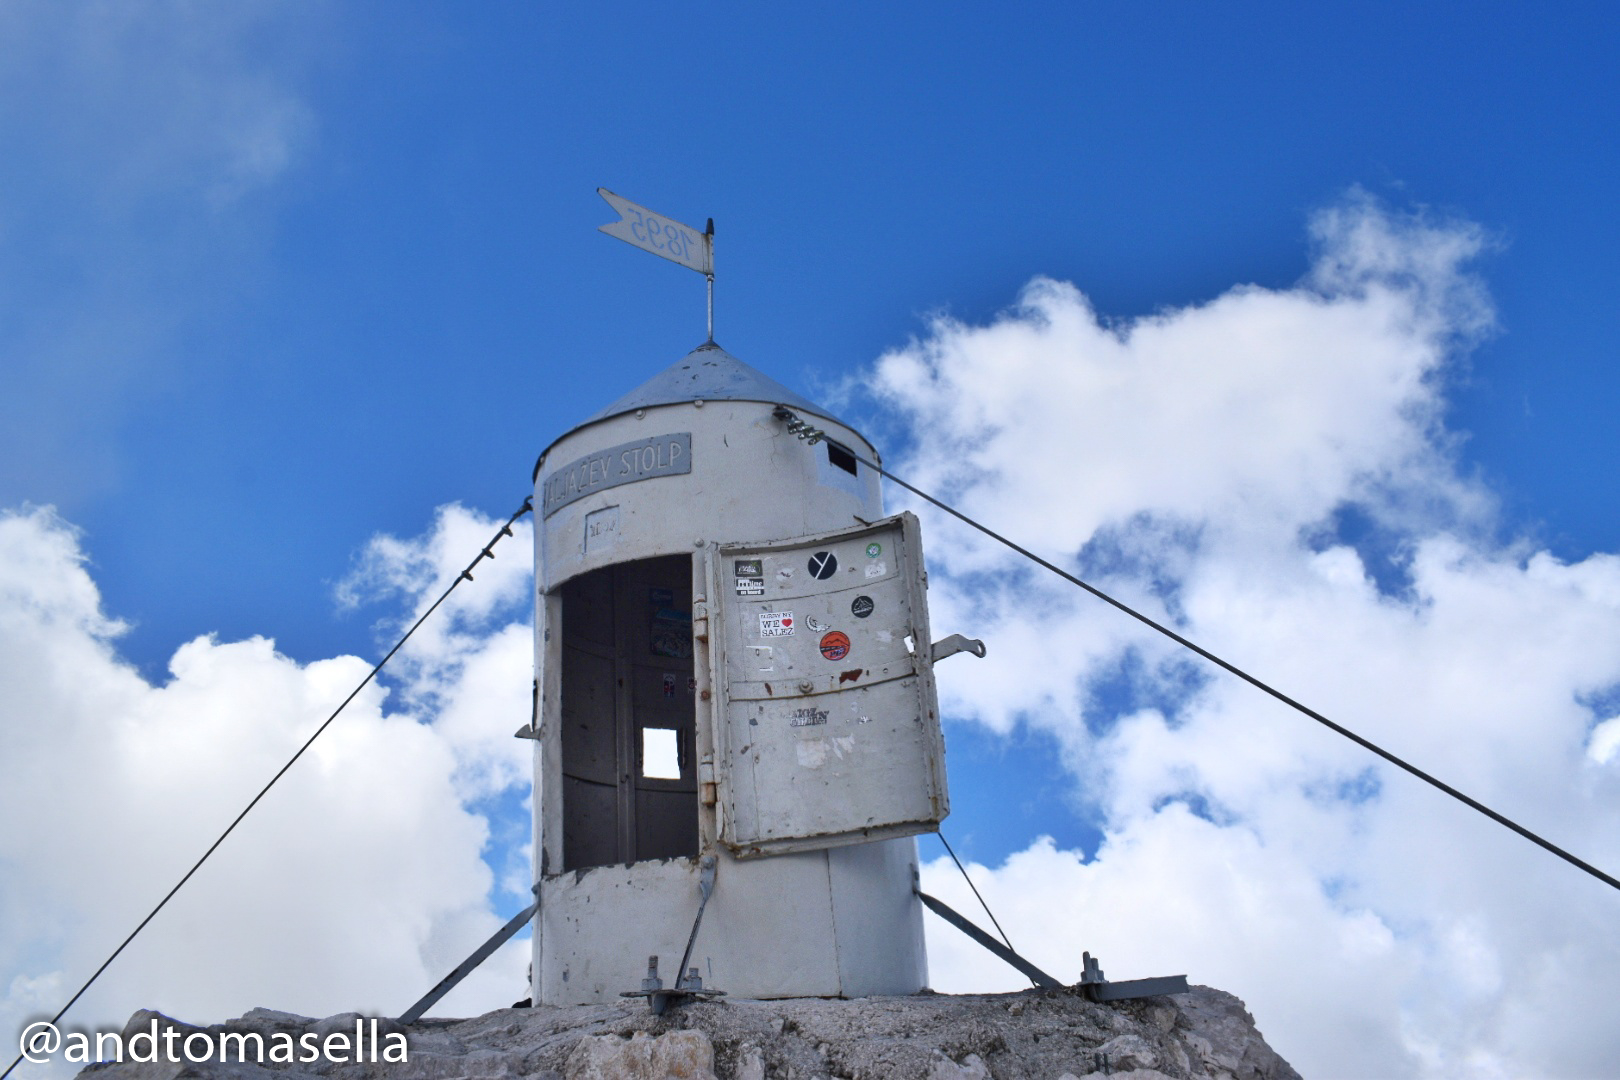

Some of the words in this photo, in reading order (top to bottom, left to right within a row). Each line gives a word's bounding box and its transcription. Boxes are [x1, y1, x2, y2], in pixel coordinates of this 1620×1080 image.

[619, 441, 682, 476] STOLP
[762, 620, 780, 629] WE
[762, 628, 794, 637] SALEZ
